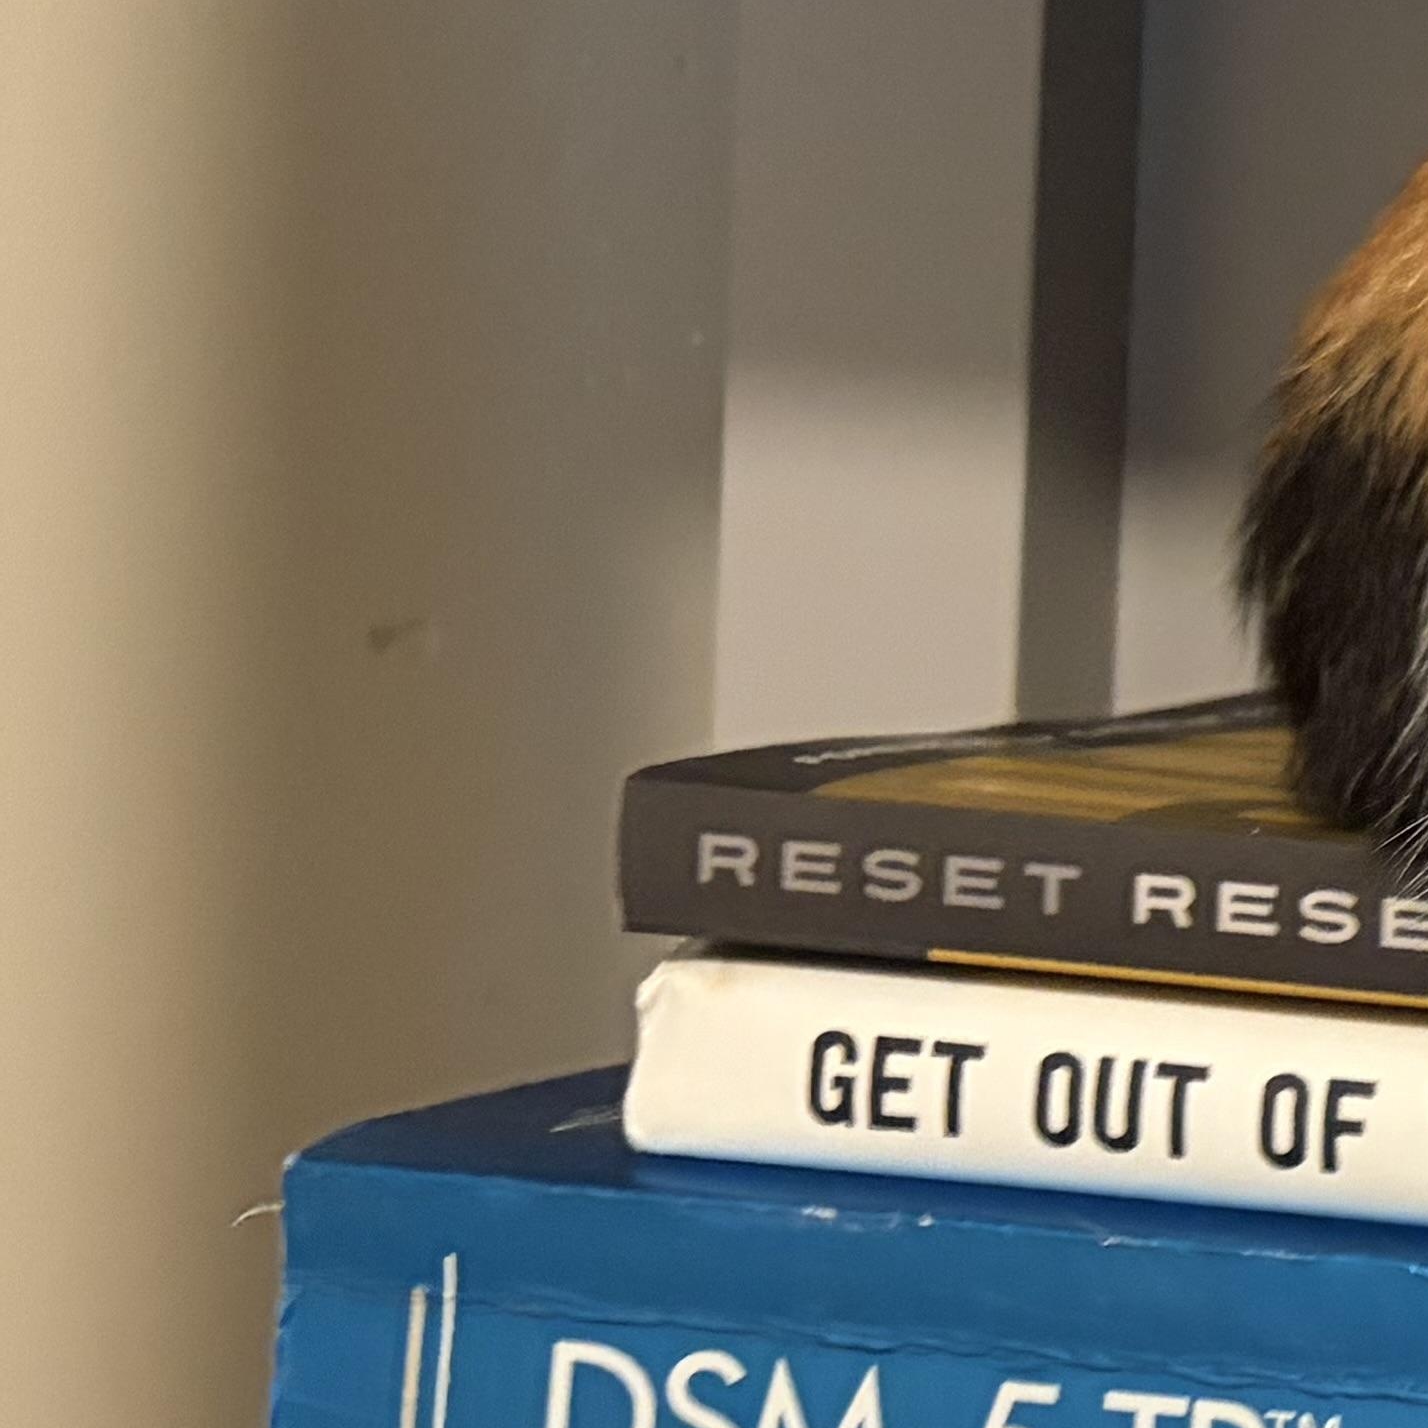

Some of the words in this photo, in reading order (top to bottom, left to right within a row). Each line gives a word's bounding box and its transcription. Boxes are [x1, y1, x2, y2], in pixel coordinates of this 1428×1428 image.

[696, 829, 1082, 916] RESET
[809, 1029, 985, 1137] GET
[1035, 1050, 1211, 1160] OUT
[1261, 1072, 1377, 1172] OF
